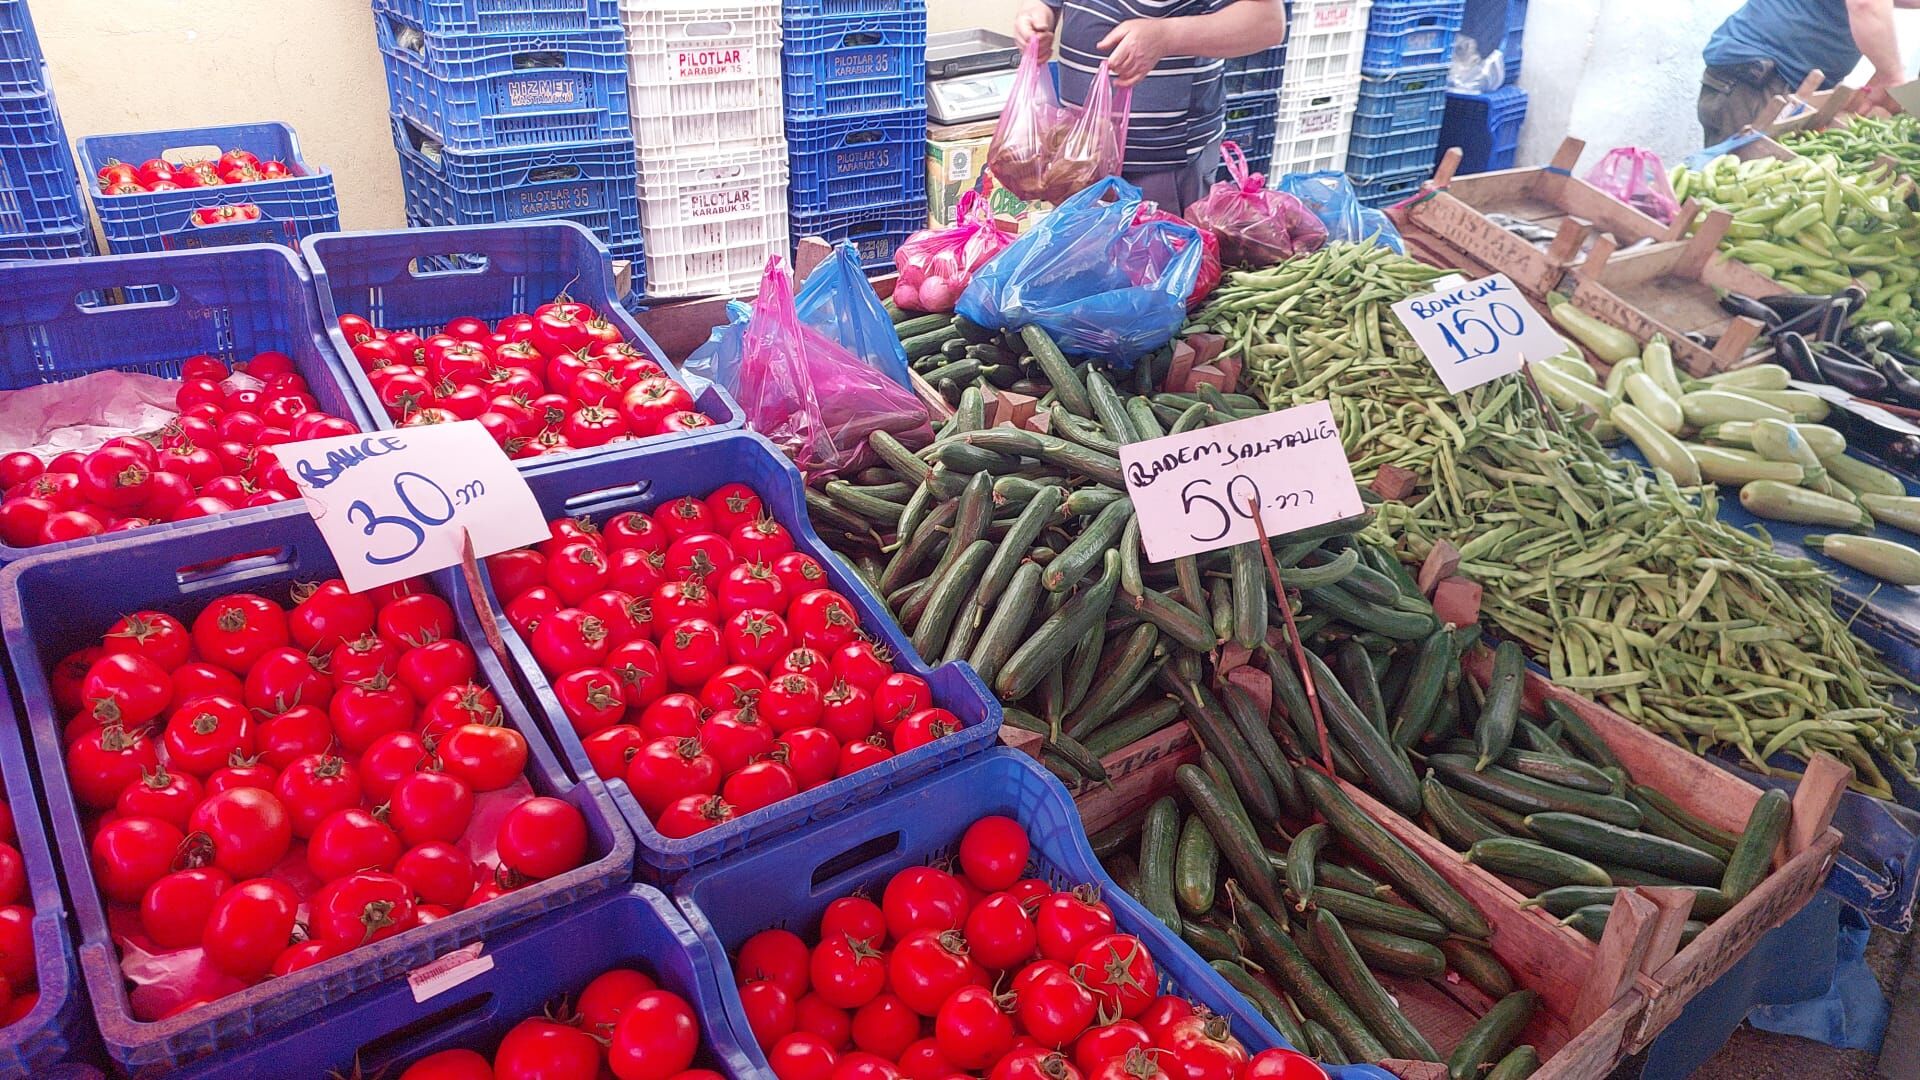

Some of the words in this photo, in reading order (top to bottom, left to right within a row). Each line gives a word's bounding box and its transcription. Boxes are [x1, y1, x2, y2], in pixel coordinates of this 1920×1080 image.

[680, 65, 728, 77] KARABUK
[835, 64, 874, 77] KARABUK
[875, 53, 889, 72] 35
[876, 149, 889, 167] 35
[520, 188, 570, 204] PILOTLAR
[573, 187, 589, 207] 35
[522, 199, 571, 214] KARABUK
[692, 204, 738, 217] KARABUK
[1410, 279, 1512, 320] BONCUK
[1437, 302, 1524, 364] 150
